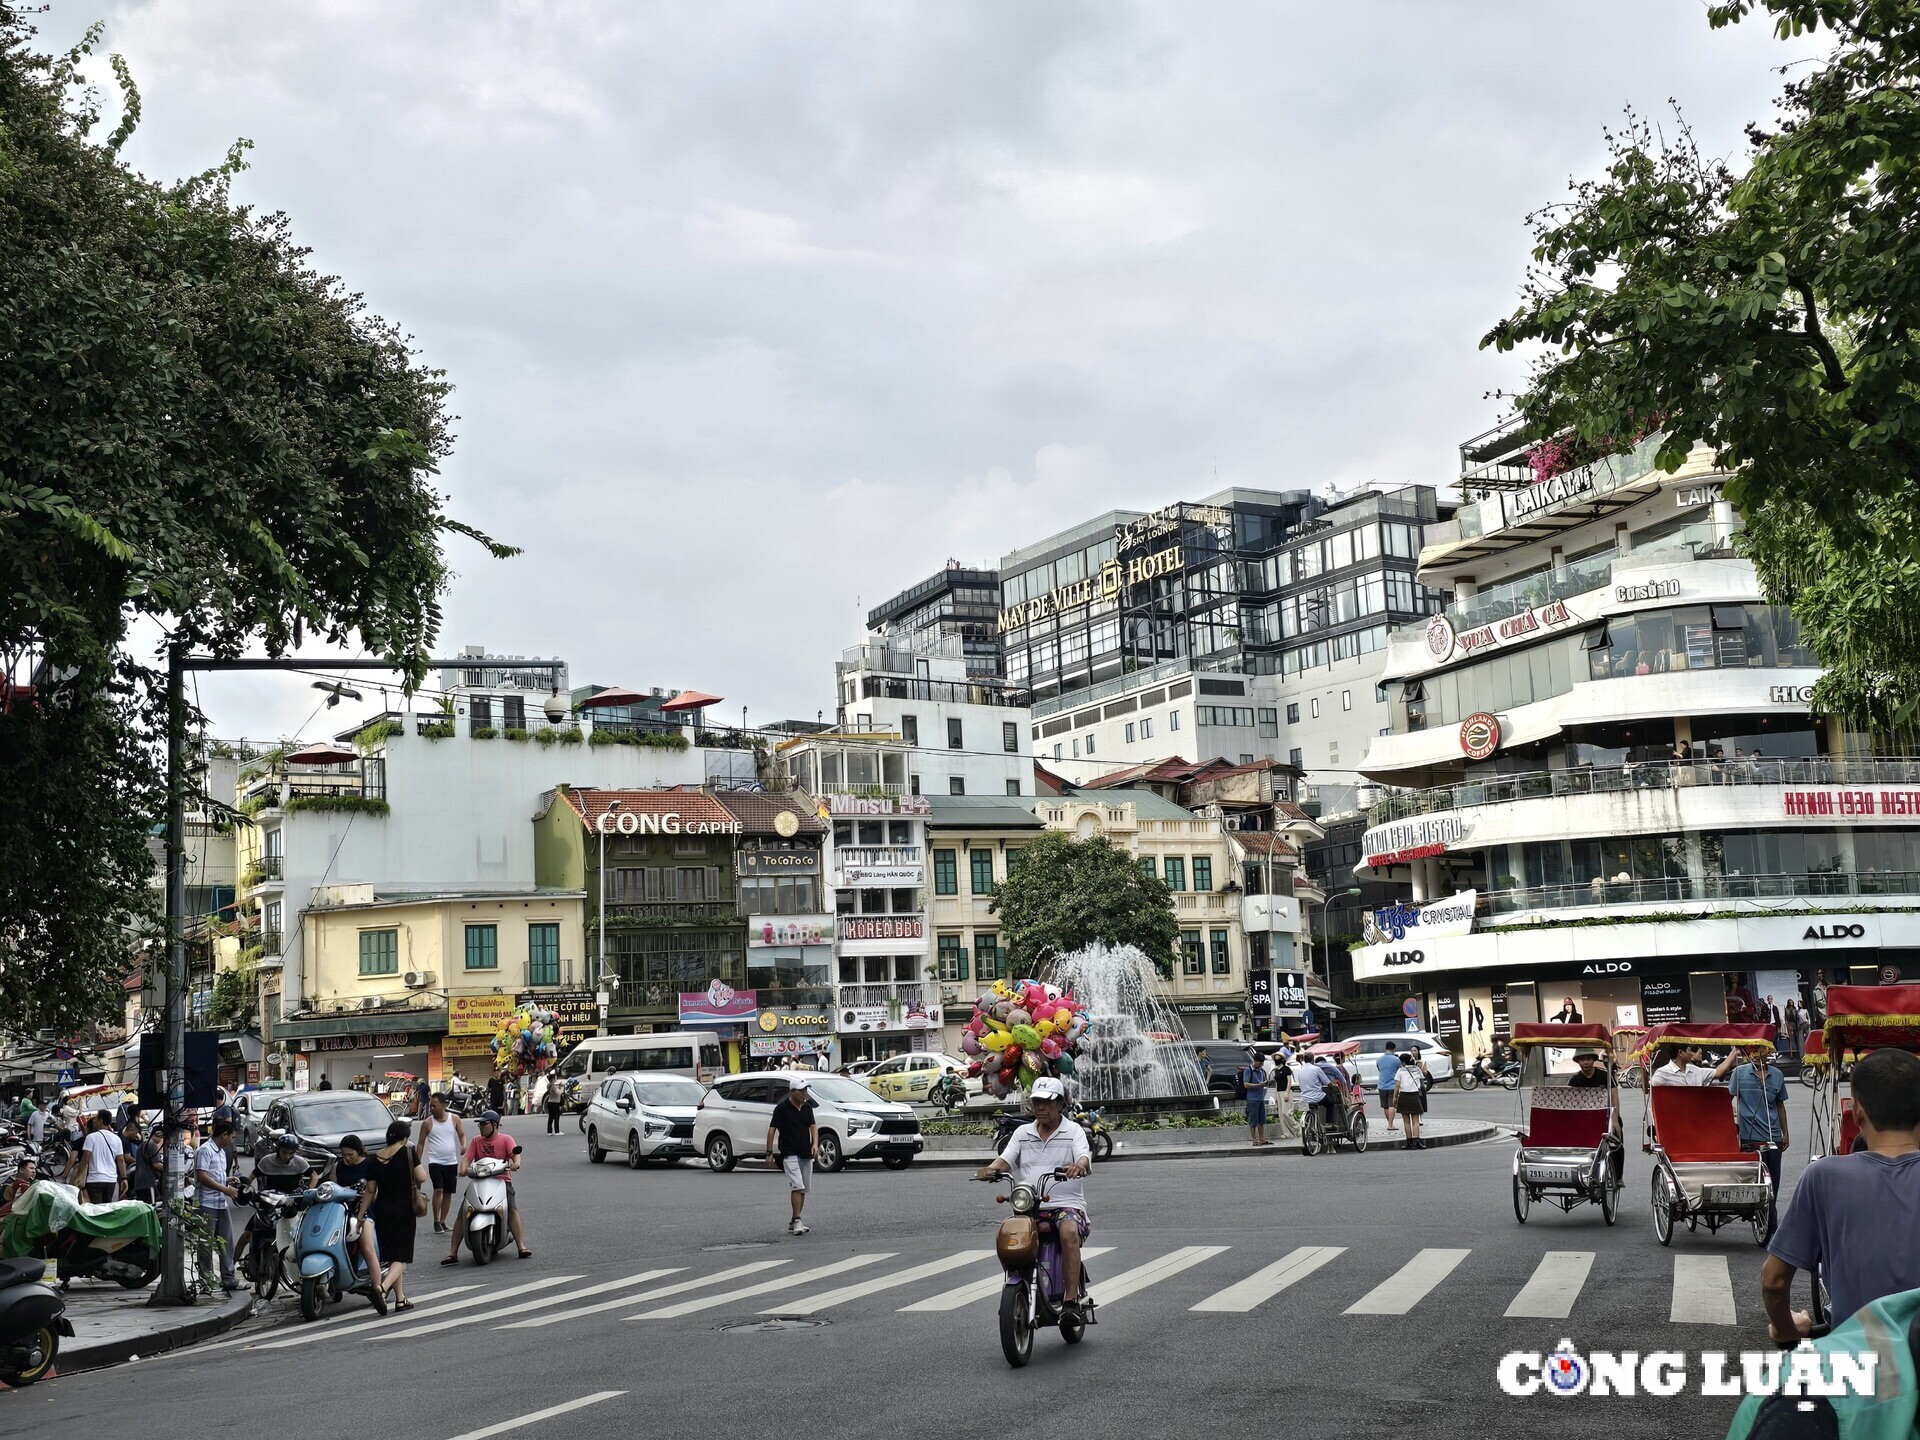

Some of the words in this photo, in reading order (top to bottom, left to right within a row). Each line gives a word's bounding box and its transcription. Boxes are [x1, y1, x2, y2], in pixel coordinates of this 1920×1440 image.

[1513, 475, 1569, 518] LAIKA
[1676, 484, 1721, 507] LAIK
[1132, 533, 1146, 546] SKY
[1147, 520, 1180, 541] LOUNGE
[997, 602, 1027, 635] MAY
[1029, 594, 1049, 621] DE
[1050, 578, 1092, 612] VILLE
[1128, 545, 1185, 586] HOTEL
[1661, 578, 1680, 597] 10
[1459, 625, 1496, 652] VUA
[1769, 684, 1816, 703] HIG
[1461, 715, 1496, 738] HIGHLANDS
[1467, 742, 1494, 757] COFFEE
[831, 793, 894, 815] Minsu
[1837, 791, 1875, 815] 1930
[685, 820, 743, 835] CAPHE
[1389, 823, 1414, 849] 1930
[1418, 816, 1463, 843] BISTRO
[848, 920, 892, 939] KOREA
[896, 920, 923, 938] BBQ
[1375, 903, 1420, 940] Tiger
[1421, 905, 1474, 925] CRYSTAL
[1802, 923, 1865, 940] ALDO
[1383, 950, 1425, 966] ALDO
[1582, 961, 1632, 975] ALDO
[1254, 980, 1267, 991] FS
[1278, 986, 1290, 1001] FS
[1289, 986, 1306, 1001] SPA
[1180, 1003, 1218, 1012] Vietcombank
[1252, 993, 1272, 1005] SPA
[1221, 1014, 1235, 1022] ATM
